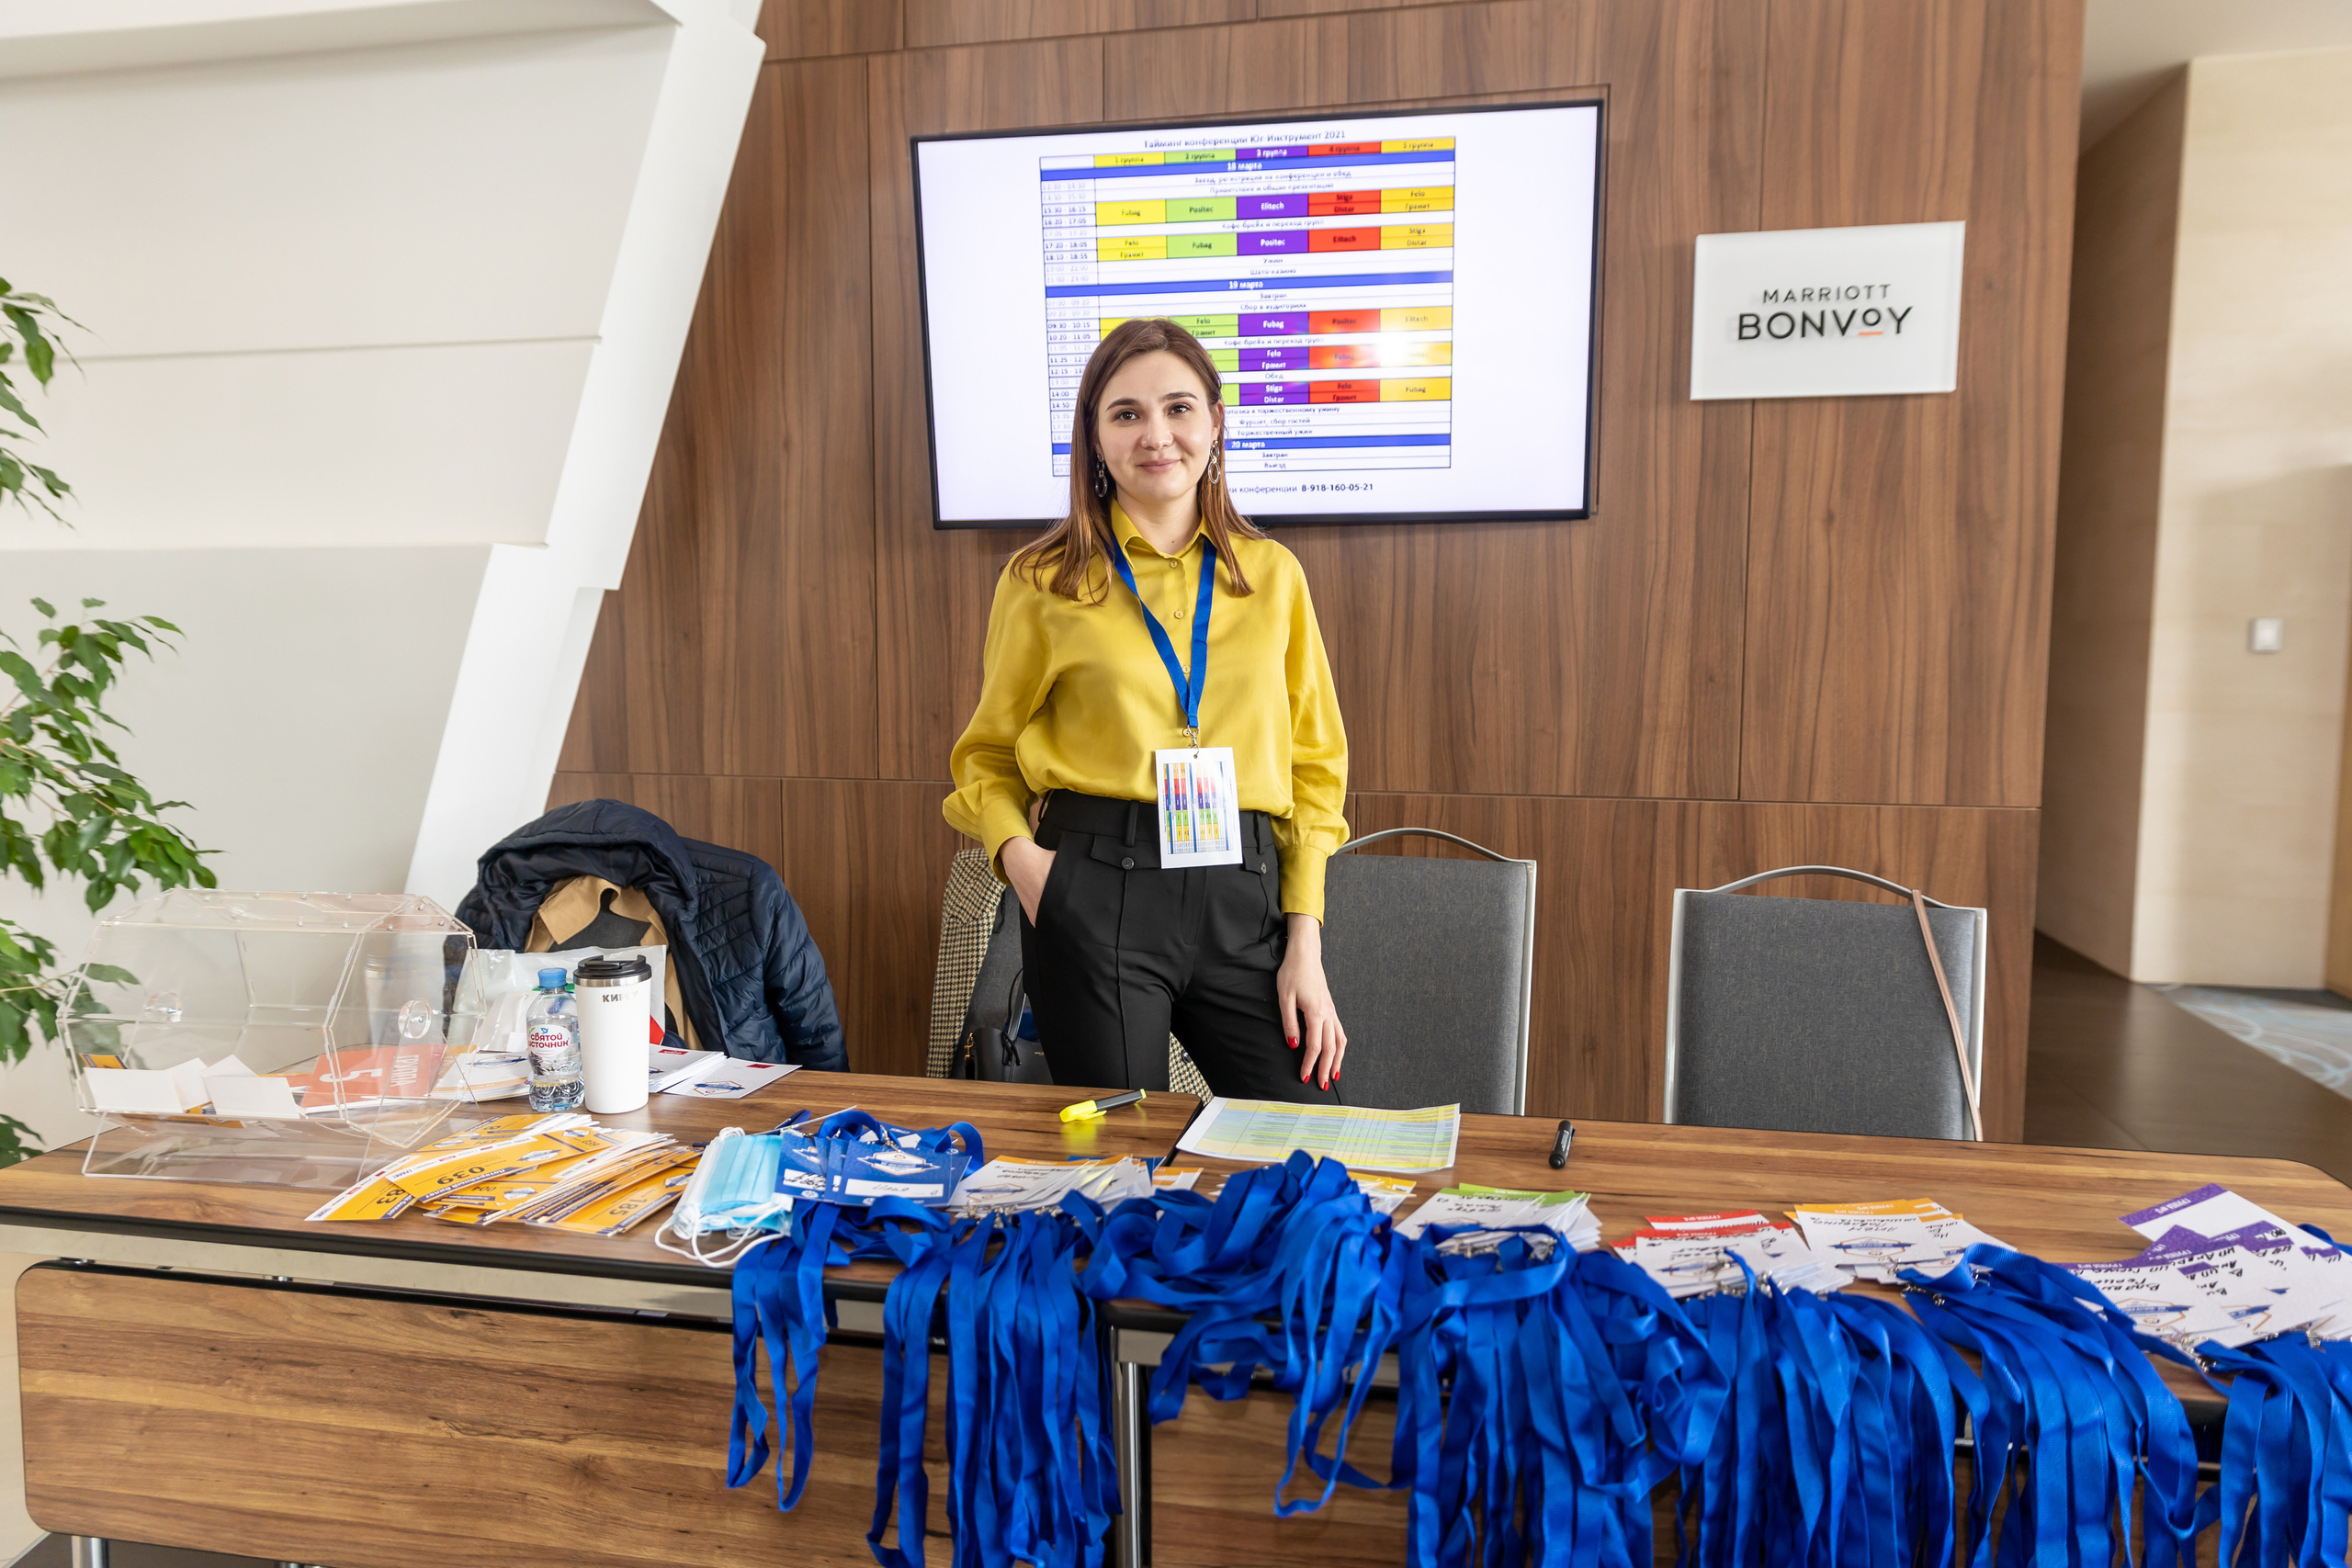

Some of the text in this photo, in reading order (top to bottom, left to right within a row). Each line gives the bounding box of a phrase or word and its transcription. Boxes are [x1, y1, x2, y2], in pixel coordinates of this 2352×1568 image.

[1144, 139, 1182, 149] Тайминг
[1185, 137, 1248, 147] конференции
[1324, 130, 1346, 139] 2021
[1262, 148, 1288, 158] группа
[1335, 145, 1360, 153] группа
[1192, 153, 1215, 161] группа
[1227, 161, 1262, 172] 18 марта
[1336, 192, 1353, 202] Stiga
[1189, 205, 1213, 214] Positec
[1261, 201, 1285, 211] Elitech
[1409, 227, 1425, 235] Stiga
[1192, 242, 1212, 250] Fubag
[1260, 238, 1285, 248] Positec
[1228, 280, 1263, 291] 19 марта
[1763, 283, 1892, 305] MARRIOTT
[1263, 320, 1284, 329] Fubag
[1737, 305, 1914, 341] BONVOY
[1267, 349, 1281, 358] Felo
[1265, 384, 1283, 393] Stiga
[1264, 395, 1285, 403] Distar
[1231, 441, 1266, 450] 20 марта
[1240, 485, 1297, 494] конференции
[1301, 483, 1374, 492] 8-918-160-05-21
[319, 1068, 383, 1083] 5
[390, 1055, 419, 1088] ГРУППА
[437, 1167, 485, 1185] 039
[609, 1199, 647, 1216] 185
